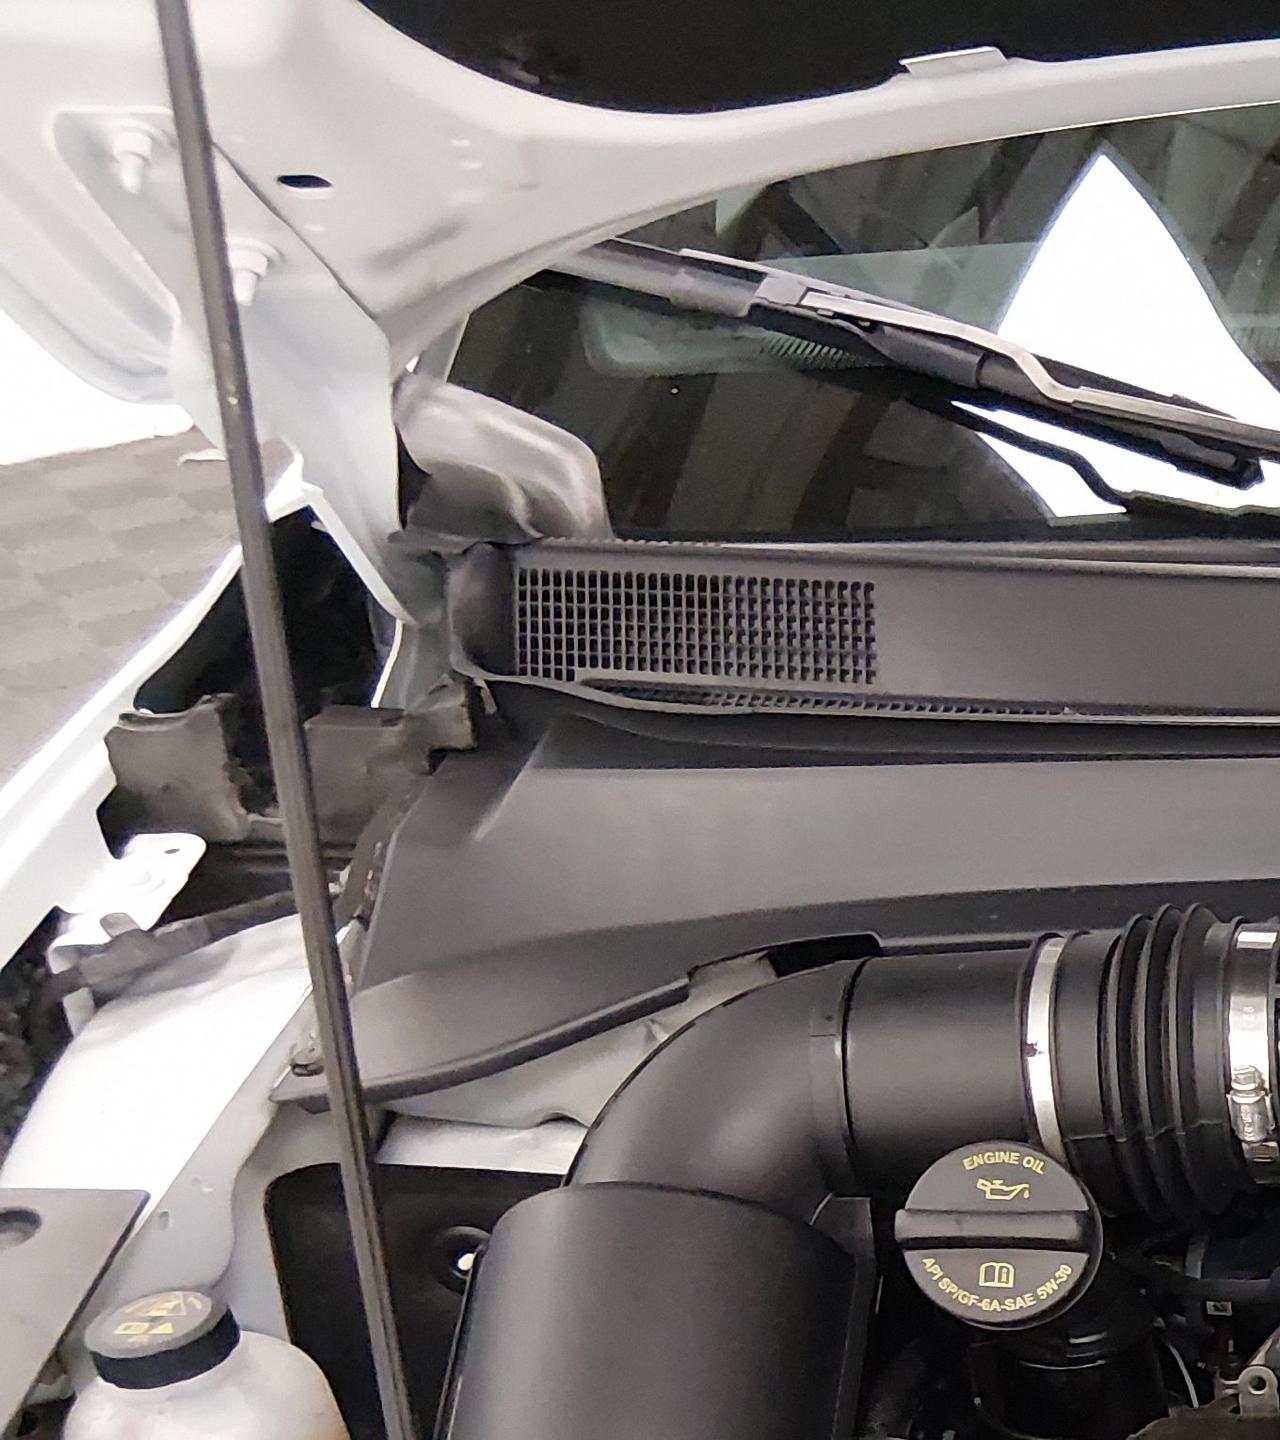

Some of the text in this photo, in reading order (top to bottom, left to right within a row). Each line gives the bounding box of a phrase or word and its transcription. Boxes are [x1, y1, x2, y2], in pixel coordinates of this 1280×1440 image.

[962, 1151, 1047, 1175] ENGINE OIL
[921, 1257, 943, 1283] API
[1035, 1264, 1073, 1300] 5W-30
